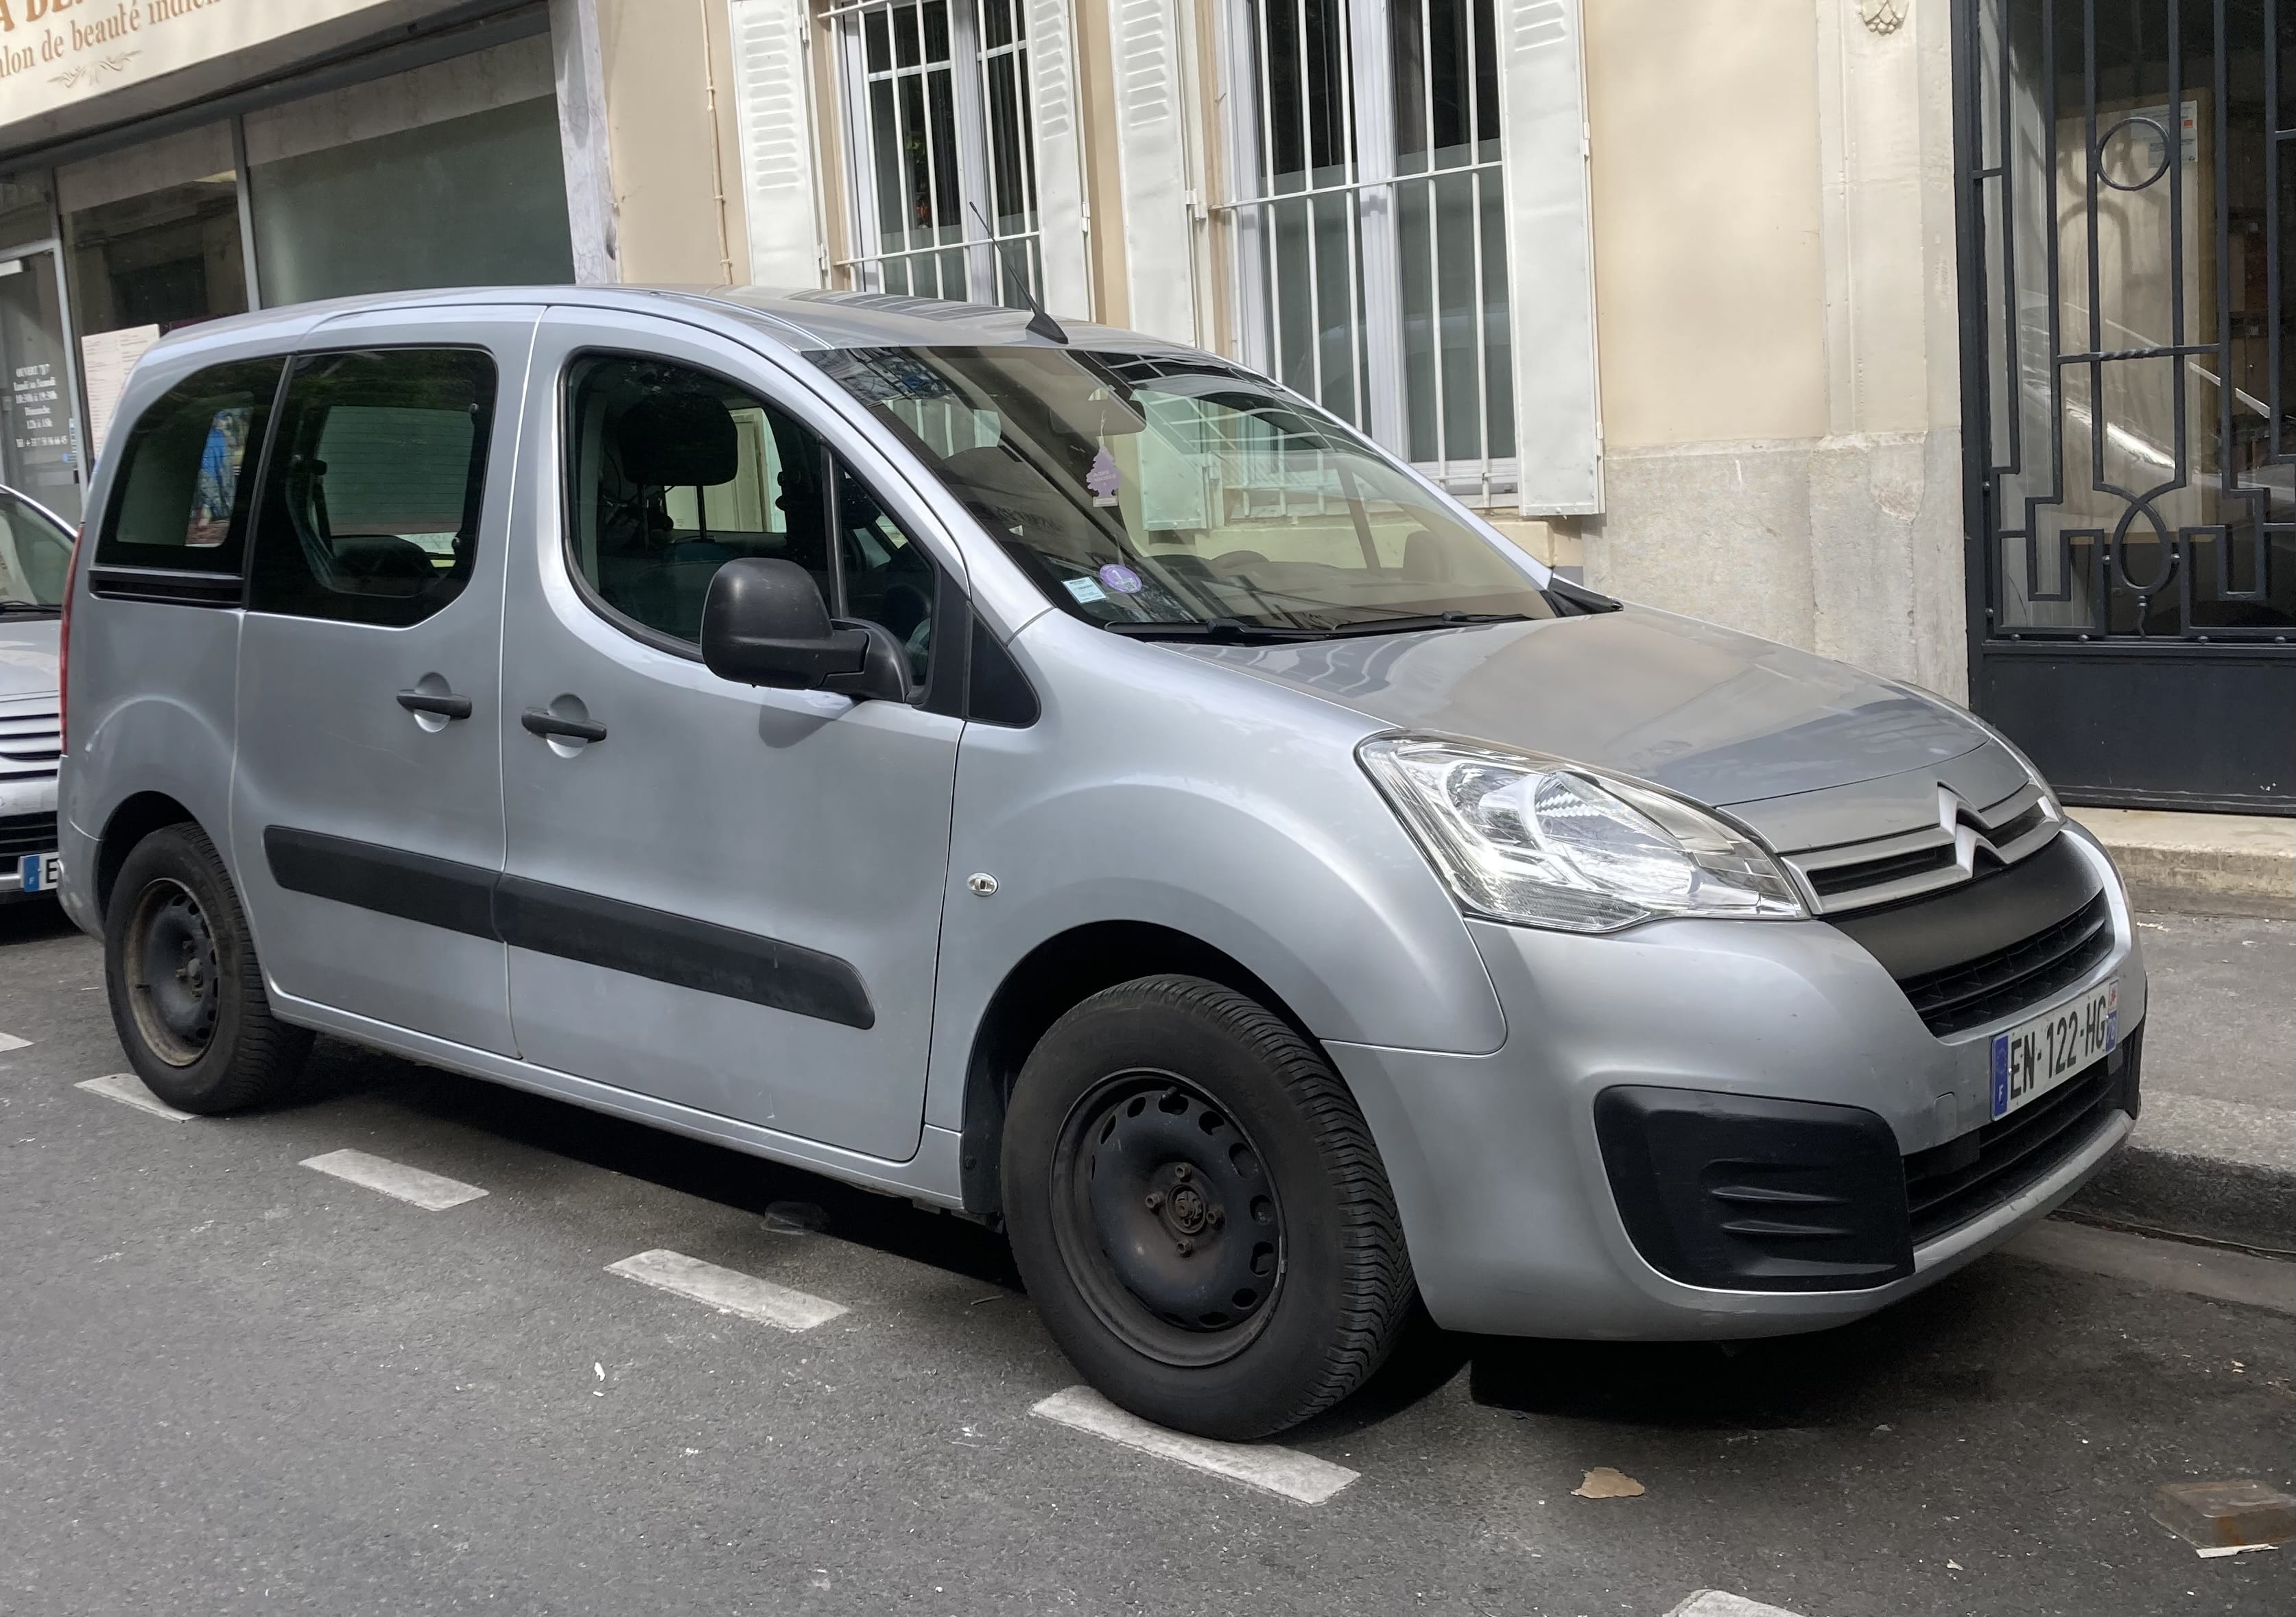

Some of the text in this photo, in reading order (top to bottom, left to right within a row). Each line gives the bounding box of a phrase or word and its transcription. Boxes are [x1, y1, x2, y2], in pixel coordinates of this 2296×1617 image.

[41, 28, 64, 62] de
[70, 0, 140, 51] beauté
[1998, 1084, 2004, 1102] F
[2011, 995, 2106, 1100] EN-122-HG
